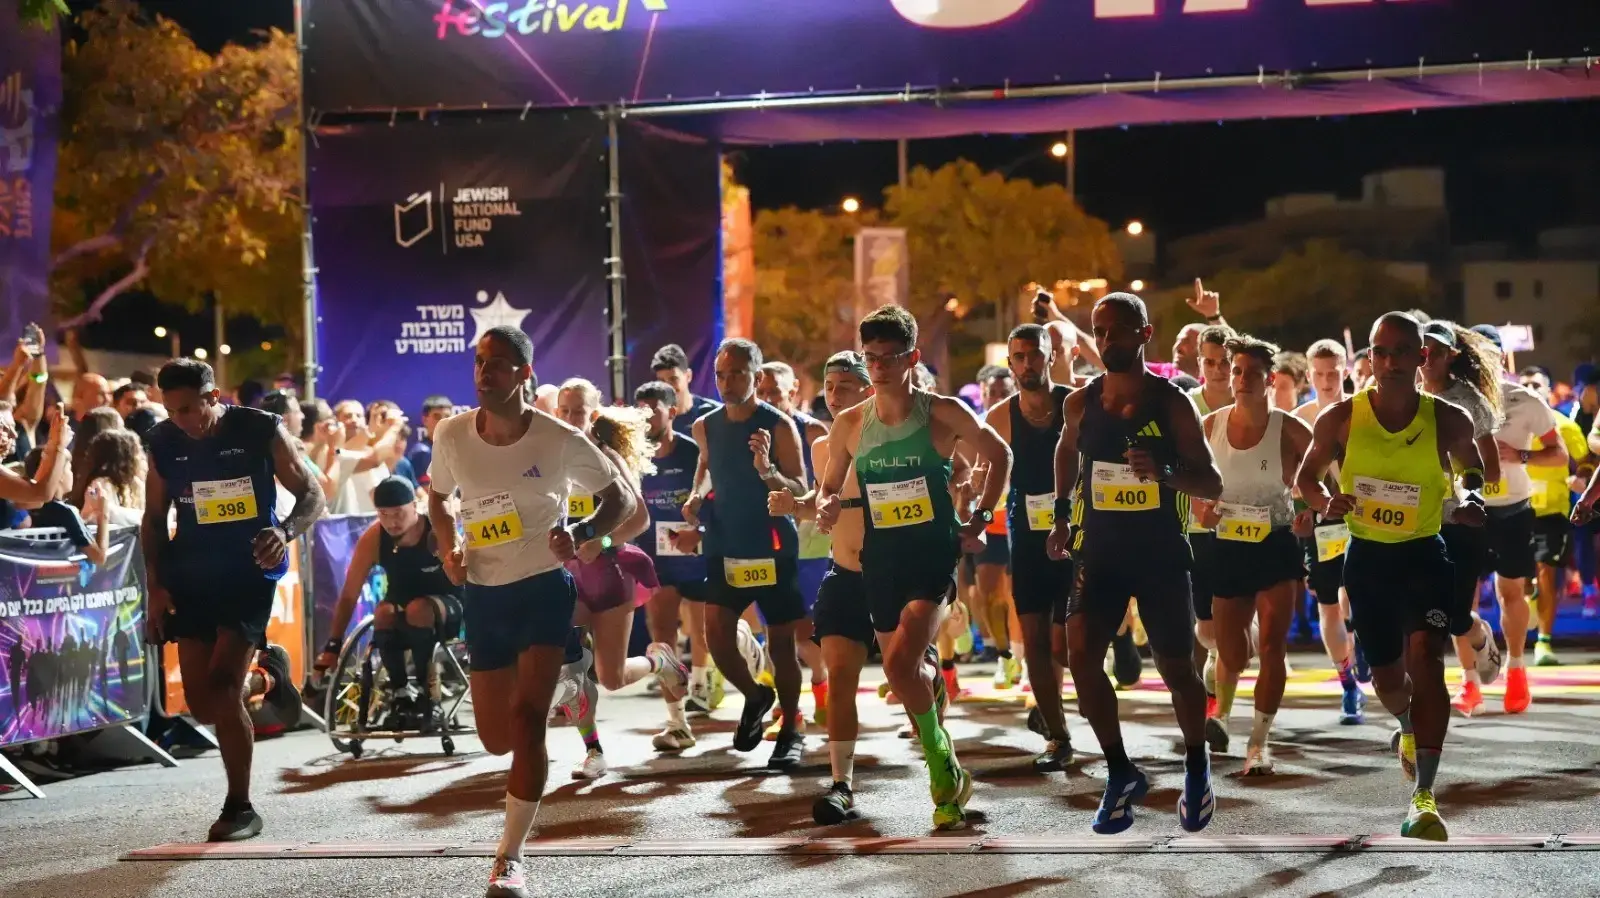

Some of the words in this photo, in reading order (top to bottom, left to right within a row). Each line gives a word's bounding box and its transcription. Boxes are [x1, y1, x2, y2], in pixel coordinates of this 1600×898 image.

[453, 187, 509, 202] JEWISH
[453, 202, 522, 217] NATIONAL
[454, 218, 492, 232] FUND
[455, 234, 484, 248] USA
[416, 305, 465, 320] משרד
[401, 321, 465, 338] התרבות
[395, 338, 466, 354] והספורט
[869, 456, 921, 468] MULTI
[1114, 490, 1147, 505] 400
[216, 501, 246, 517] 398
[892, 503, 923, 520] 123
[1371, 507, 1405, 526] 409
[481, 520, 511, 540] 414
[1235, 524, 1261, 538] 417
[743, 568, 768, 582] 303
